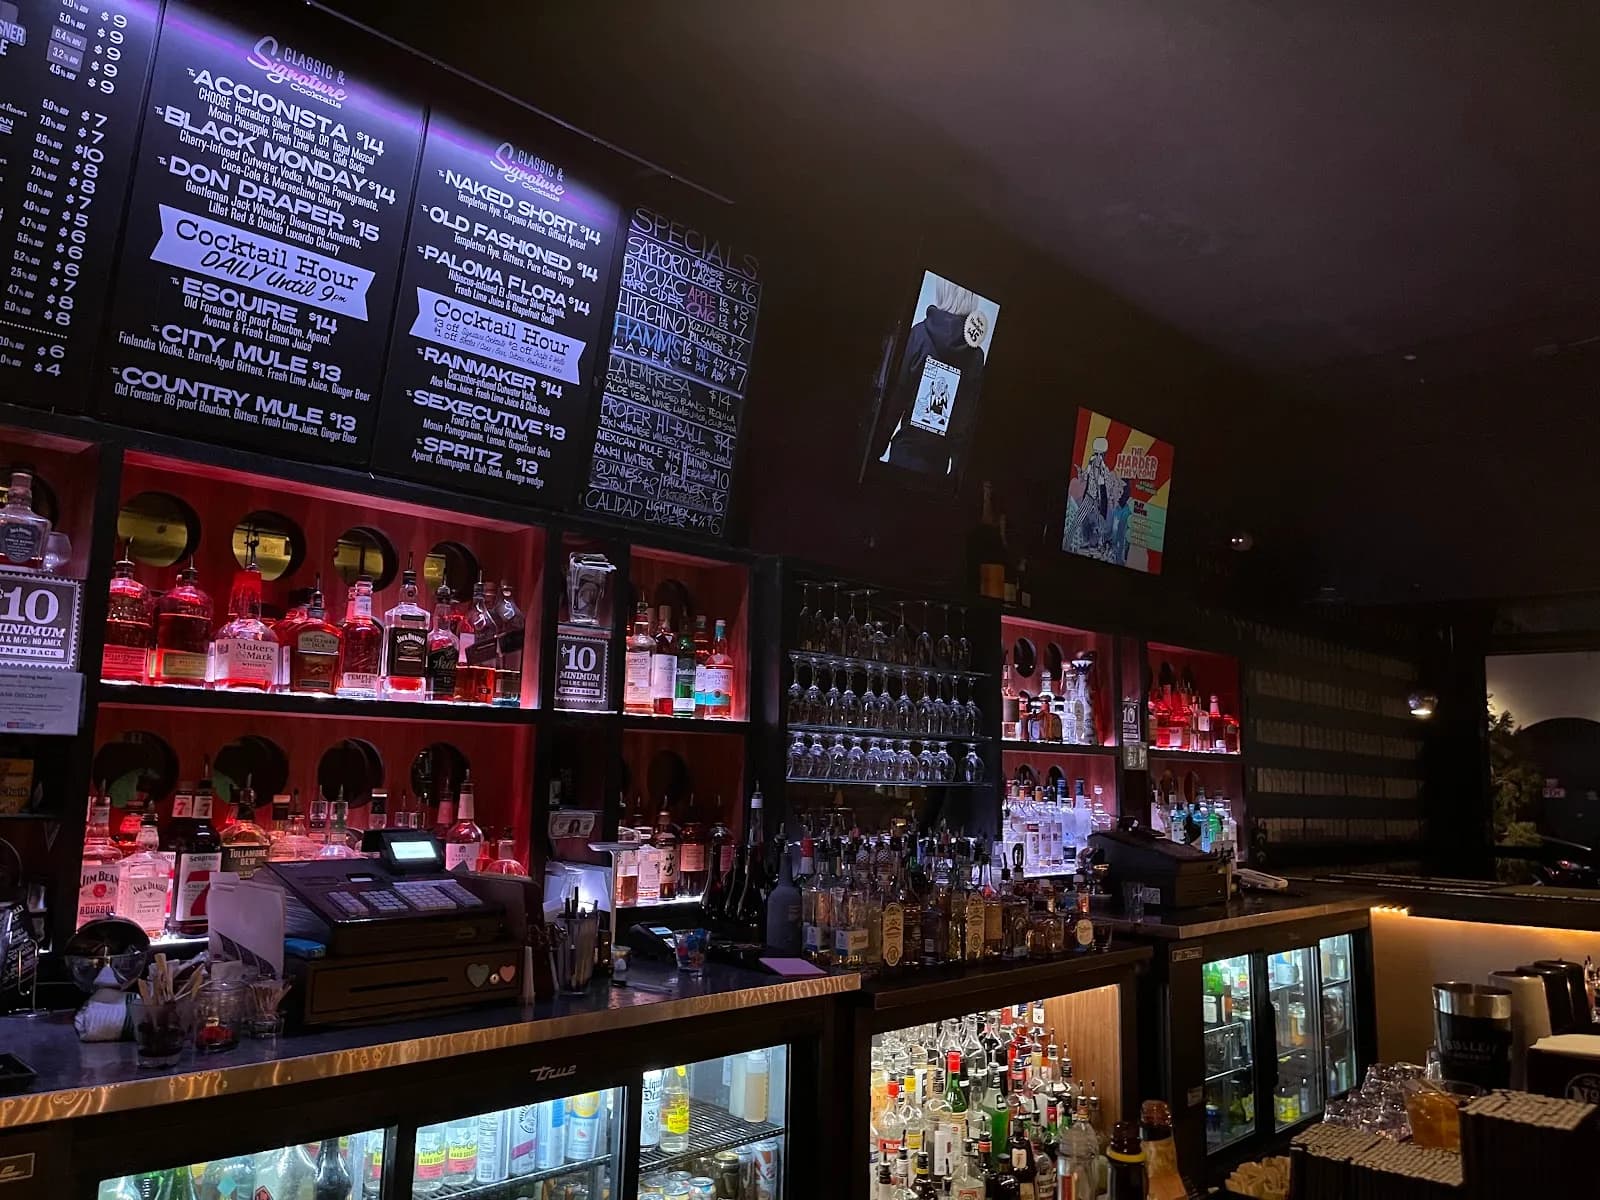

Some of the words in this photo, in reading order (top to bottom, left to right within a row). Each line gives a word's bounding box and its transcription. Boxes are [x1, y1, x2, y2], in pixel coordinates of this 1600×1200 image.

[246, 36, 348, 101] Signature
[284, 47, 334, 80] CLASSIC
[193, 69, 348, 143] ACCIONISTA
[356, 131, 385, 157] $14
[198, 87, 231, 110] CHOOSE
[235, 101, 270, 126] Herradura
[272, 116, 290, 132] Silver
[293, 122, 315, 143] Tequila
[318, 134, 330, 148] OR
[351, 146, 375, 166] Mezcal
[208, 104, 232, 124] Monin
[272, 129, 291, 147] Fresh
[292, 138, 310, 153] Lime
[332, 152, 348, 166] Club
[348, 157, 365, 174] Soda
[164, 105, 257, 154] BLACK
[262, 141, 368, 192] MONDAY
[367, 181, 396, 205] $14
[242, 152, 279, 175] Cutwater
[307, 175, 330, 194] Monin
[489, 142, 565, 196] Signature
[517, 149, 555, 178] CLASSIC
[169, 155, 230, 191] DON
[238, 178, 346, 231] DRAPER
[352, 219, 380, 242] $15
[185, 179, 229, 205] Gentleman
[231, 197, 251, 212] Jack
[289, 214, 326, 237] Disaronno
[221, 158, 261, 181] Coca-Cola
[272, 175, 316, 202] Maraschino
[317, 192, 342, 212] Cherry
[445, 169, 514, 209] NAKED
[518, 200, 578, 235] SHORT
[580, 225, 601, 245] $14
[176, 219, 288, 270] Cocktail
[295, 255, 358, 291] Hour
[208, 200, 229, 217] Lillet
[230, 207, 246, 223] Red
[257, 216, 283, 235] Double
[285, 225, 314, 245] Luxardo
[315, 236, 340, 257] Cherry
[429, 206, 470, 233] OLD
[473, 222, 572, 271] FASHIONED
[577, 262, 598, 282] $14
[632, 207, 760, 280] SPECIALS
[200, 250, 268, 281] DAILY
[266, 271, 317, 297] Until
[424, 244, 503, 286] PALOMA
[507, 274, 566, 309] FLORA
[568, 296, 590, 316] $14
[623, 255, 688, 297] BIVOUAC
[627, 236, 690, 277] SAPPORO
[182, 277, 298, 324] ESQUIRE
[308, 312, 338, 334] $14
[183, 295, 198, 309] Old
[200, 300, 234, 319] Forester
[248, 314, 270, 330] proof
[687, 285, 716, 309] APPLE
[161, 323, 226, 353] CITY
[233, 341, 309, 375] MULE
[312, 361, 342, 383] $13
[202, 314, 230, 331] Averna
[241, 324, 263, 340] Fresh
[265, 330, 290, 347] Lemon
[291, 338, 312, 352] Juice
[434, 299, 517, 340] Cocktail
[521, 327, 570, 356] Hour
[118, 331, 156, 351] Finlandia
[267, 366, 288, 382] Fresh
[289, 374, 306, 387] Lime
[331, 383, 354, 402] Ginger
[354, 388, 371, 402] Beer
[424, 346, 537, 391] RAINMAKER
[540, 380, 563, 399] $14
[114, 382, 128, 397] Old
[130, 385, 162, 403] Forester
[176, 397, 197, 411] proof
[261, 413, 280, 429] Fresh
[282, 419, 298, 431] Lime
[320, 426, 341, 443] Ginger
[342, 431, 357, 444] Beer
[122, 366, 250, 408] COUNTRY
[255, 395, 324, 425] MULE
[330, 412, 357, 432] $13
[413, 389, 543, 435] SEXECUTIVE
[544, 423, 566, 441] $13
[424, 436, 504, 467] SPRITZ
[516, 457, 539, 475] $13
[593, 442, 621, 459] RANCH
[623, 451, 656, 471] WATER
[597, 429, 636, 449] MEXICAN
[639, 442, 664, 459] MULE
[1117, 454, 1159, 470] HARDER
[585, 489, 644, 518] CALIDAD
[245, 651, 274, 661] Mark
[560, 671, 601, 681] MINIMUM
[561, 643, 597, 672] $10
[80, 874, 97, 889] JIM
[79, 904, 115, 915] BOURBON
